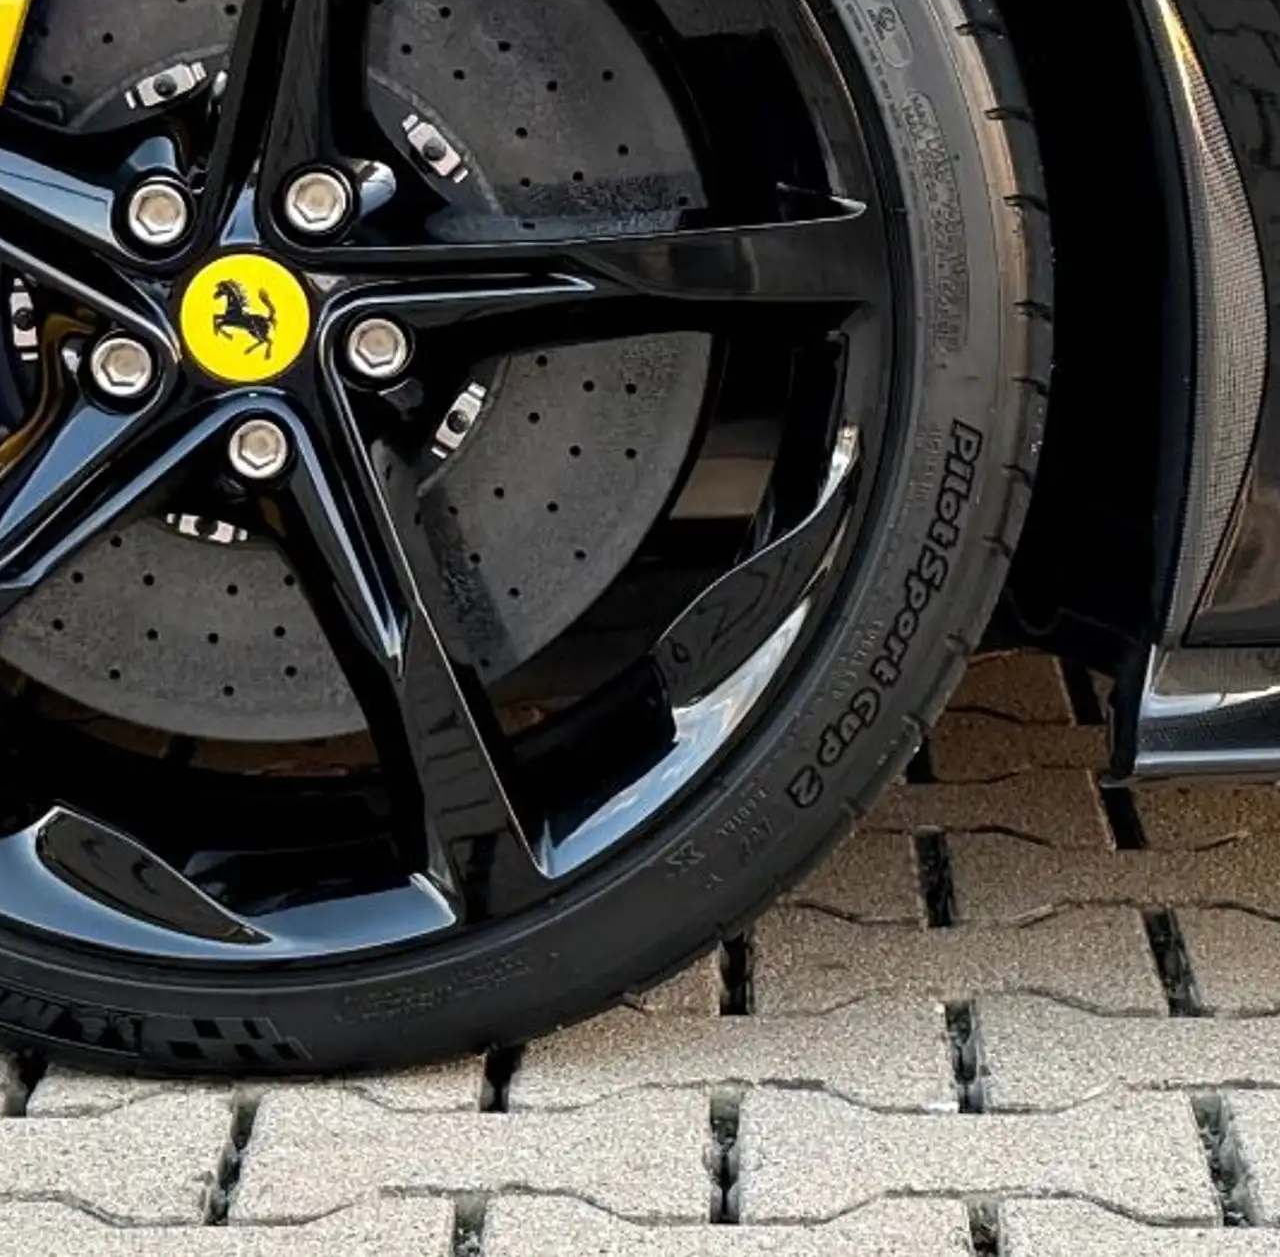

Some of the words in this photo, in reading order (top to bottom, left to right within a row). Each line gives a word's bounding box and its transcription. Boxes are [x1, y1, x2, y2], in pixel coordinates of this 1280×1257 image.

[928, 419, 982, 547] Pilot
[873, 543, 949, 688] Sport
[819, 686, 883, 768] Cup
[785, 766, 825, 809] 2
